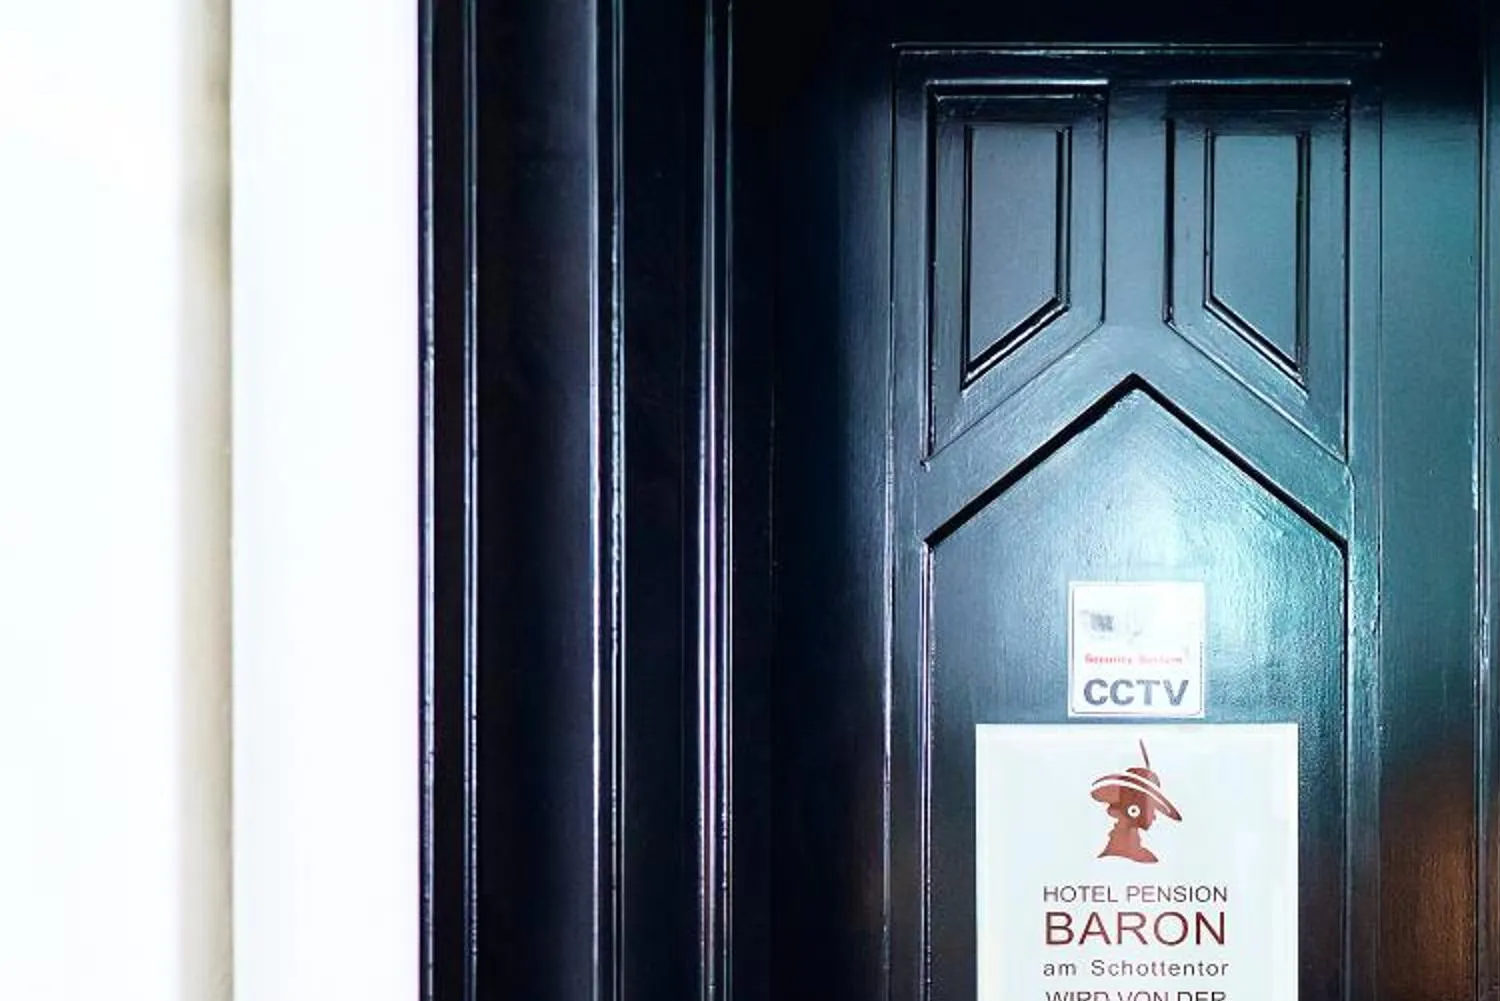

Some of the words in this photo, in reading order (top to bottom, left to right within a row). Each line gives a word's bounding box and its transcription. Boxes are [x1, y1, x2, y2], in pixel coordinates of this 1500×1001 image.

[1083, 678, 1189, 706] CCTV
[1043, 885, 1119, 903] HOTEL
[1127, 885, 1228, 903] PENSION
[1045, 911, 1225, 946] BARON
[1043, 963, 1077, 977] am
[1091, 959, 1229, 977] Schottentor
